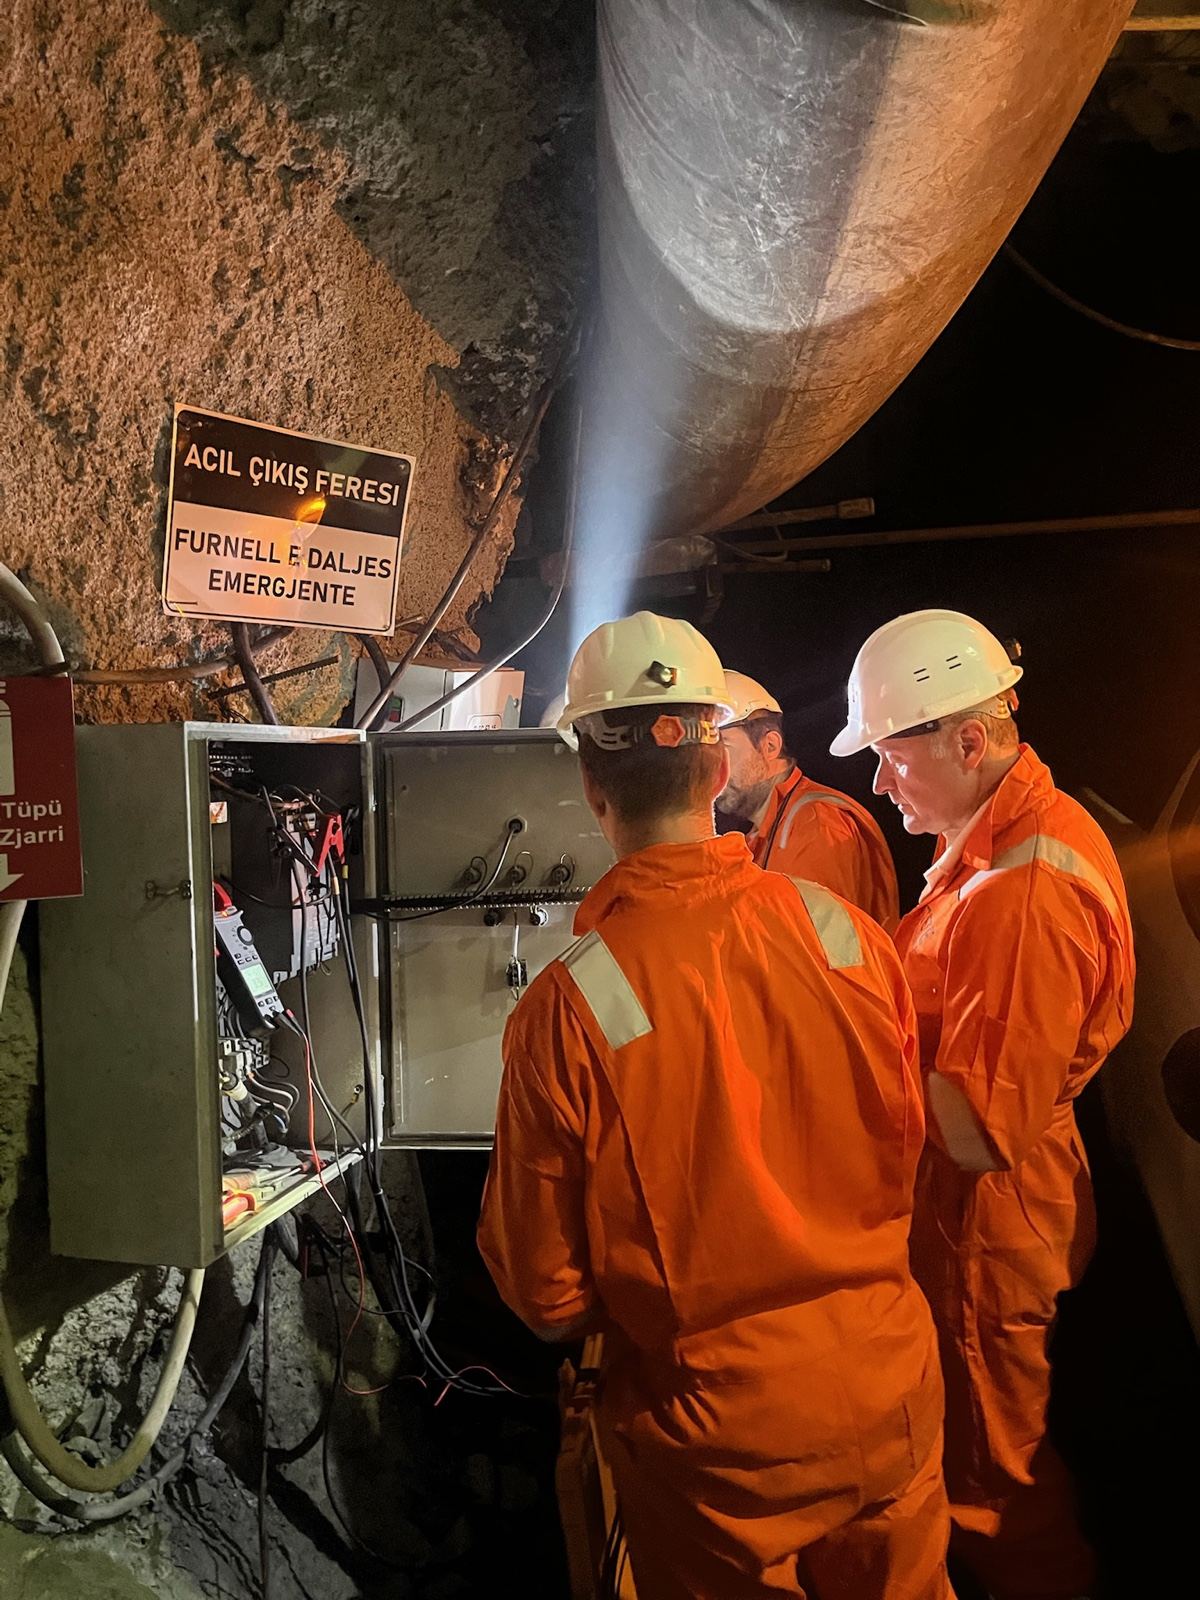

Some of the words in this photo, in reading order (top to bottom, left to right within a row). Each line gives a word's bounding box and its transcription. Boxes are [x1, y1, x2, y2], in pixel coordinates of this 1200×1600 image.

[184, 443, 241, 477] ACIL
[249, 456, 308, 495] ÇIKIŞ
[315, 470, 400, 506] FERESI
[174, 528, 281, 564] FURNELL
[307, 547, 392, 579] DALJES
[208, 569, 356, 606] EMERGJENTE
[1, 800, 62, 821] Tüpü
[0, 825, 63, 849] Zjarri
